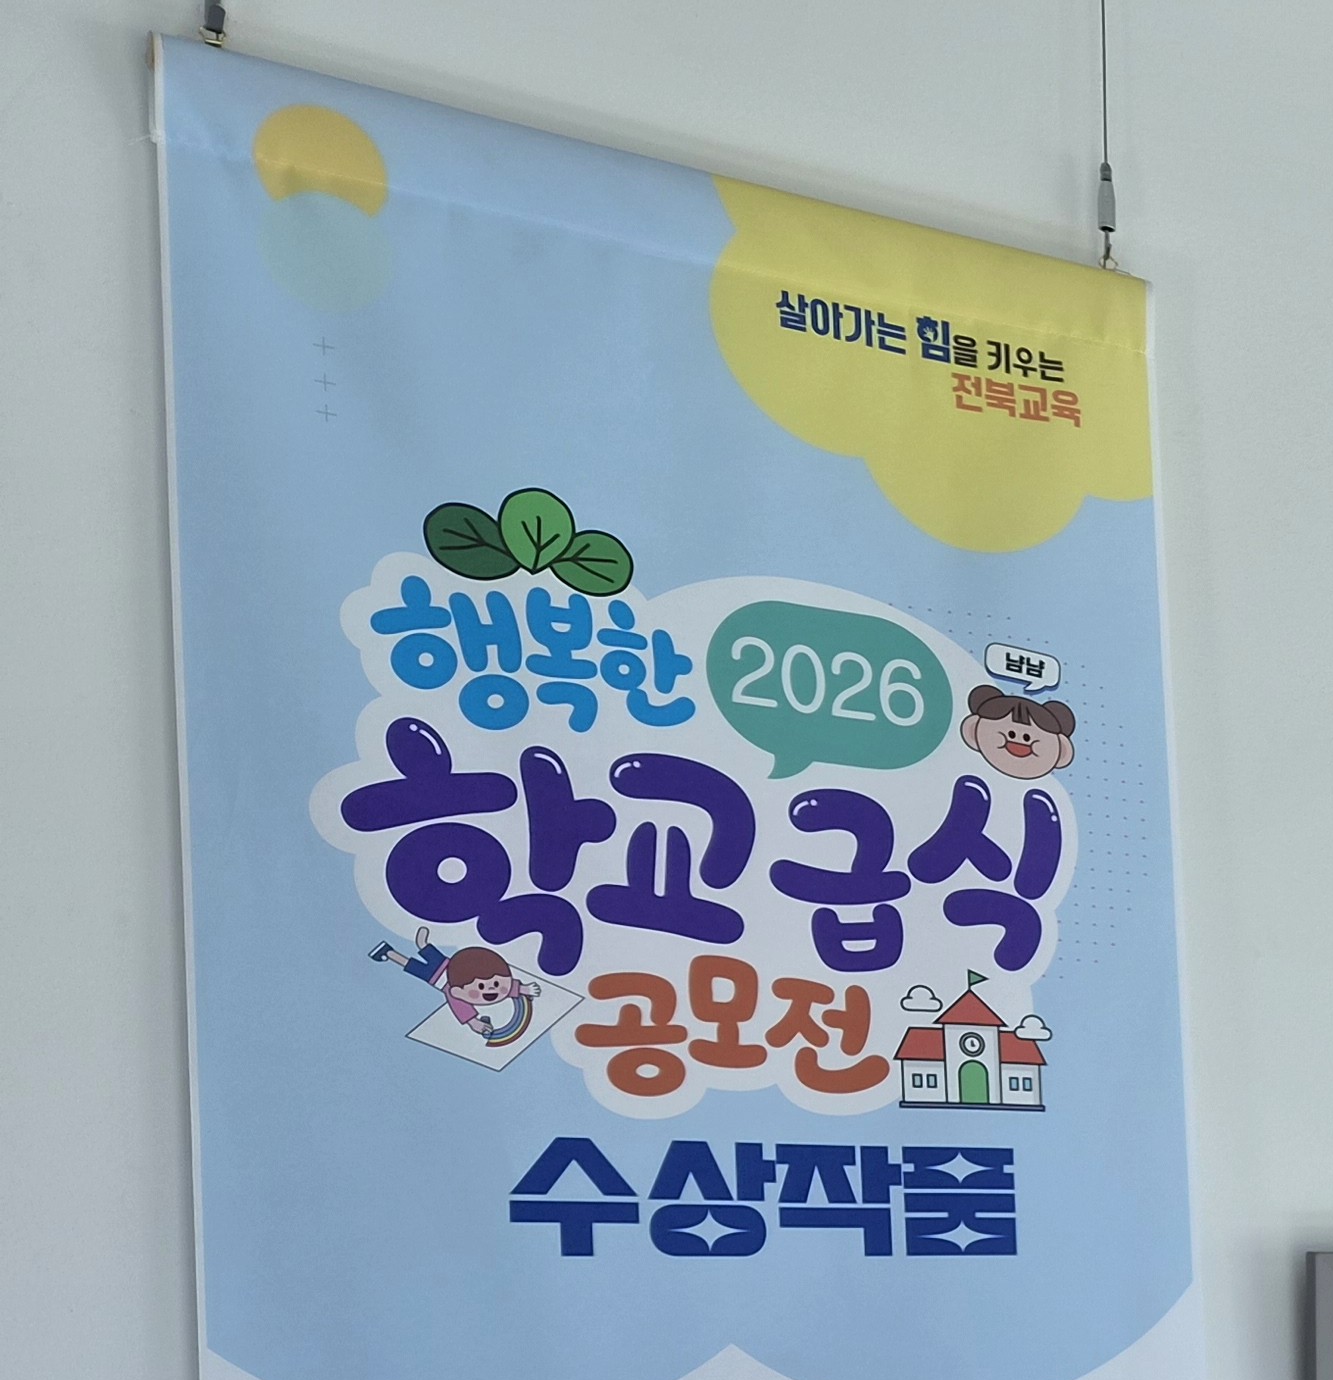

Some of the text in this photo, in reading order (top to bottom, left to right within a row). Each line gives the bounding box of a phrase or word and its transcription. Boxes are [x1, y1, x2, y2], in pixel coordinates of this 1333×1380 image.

[775, 289, 1065, 385] 살아가는 힘을 키우는
[950, 371, 1082, 429] 전북교육
[369, 575, 696, 734] 행복한
[727, 635, 926, 728] 2026
[1003, 650, 1046, 681] 냠냠
[574, 954, 891, 1098] 공모전
[508, 1136, 1018, 1257] 수상작품
